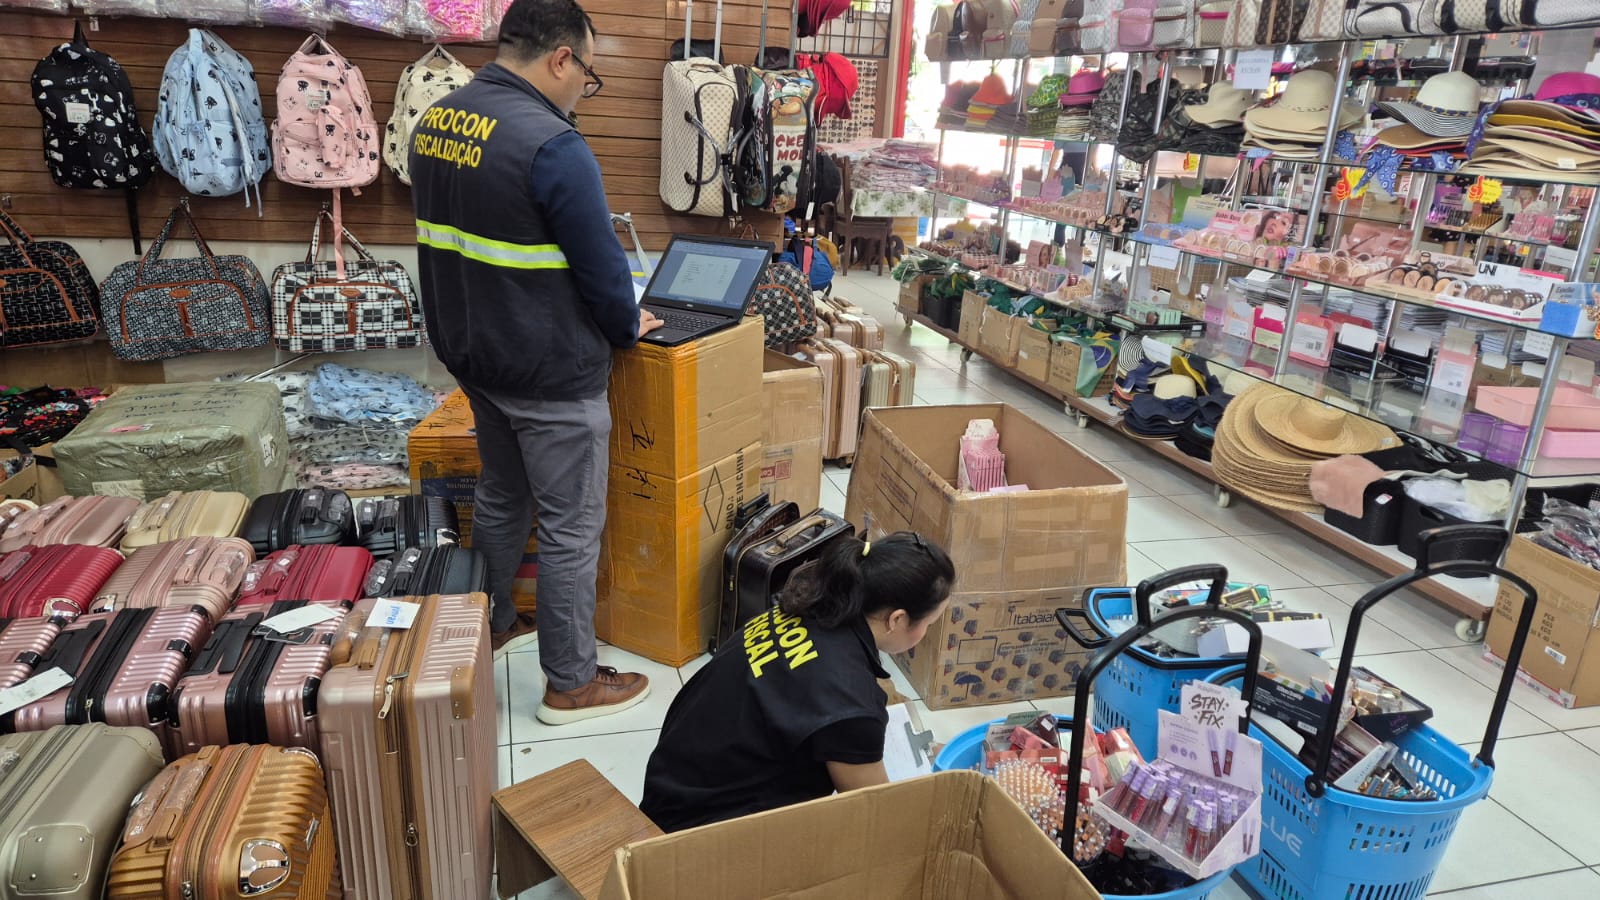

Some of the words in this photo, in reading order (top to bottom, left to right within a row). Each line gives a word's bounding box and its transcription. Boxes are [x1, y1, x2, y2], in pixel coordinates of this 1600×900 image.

[420, 107, 497, 141] PROCON
[414, 133, 482, 169] FISCALIZAÇÃO
[1478, 263, 1498, 277] UNI
[735, 447, 744, 481] CHINA
[736, 481, 744, 494] IN
[743, 612, 779, 678] FISCAL
[1191, 693, 1225, 713] STAY
[1198, 710, 1225, 729] FIX
